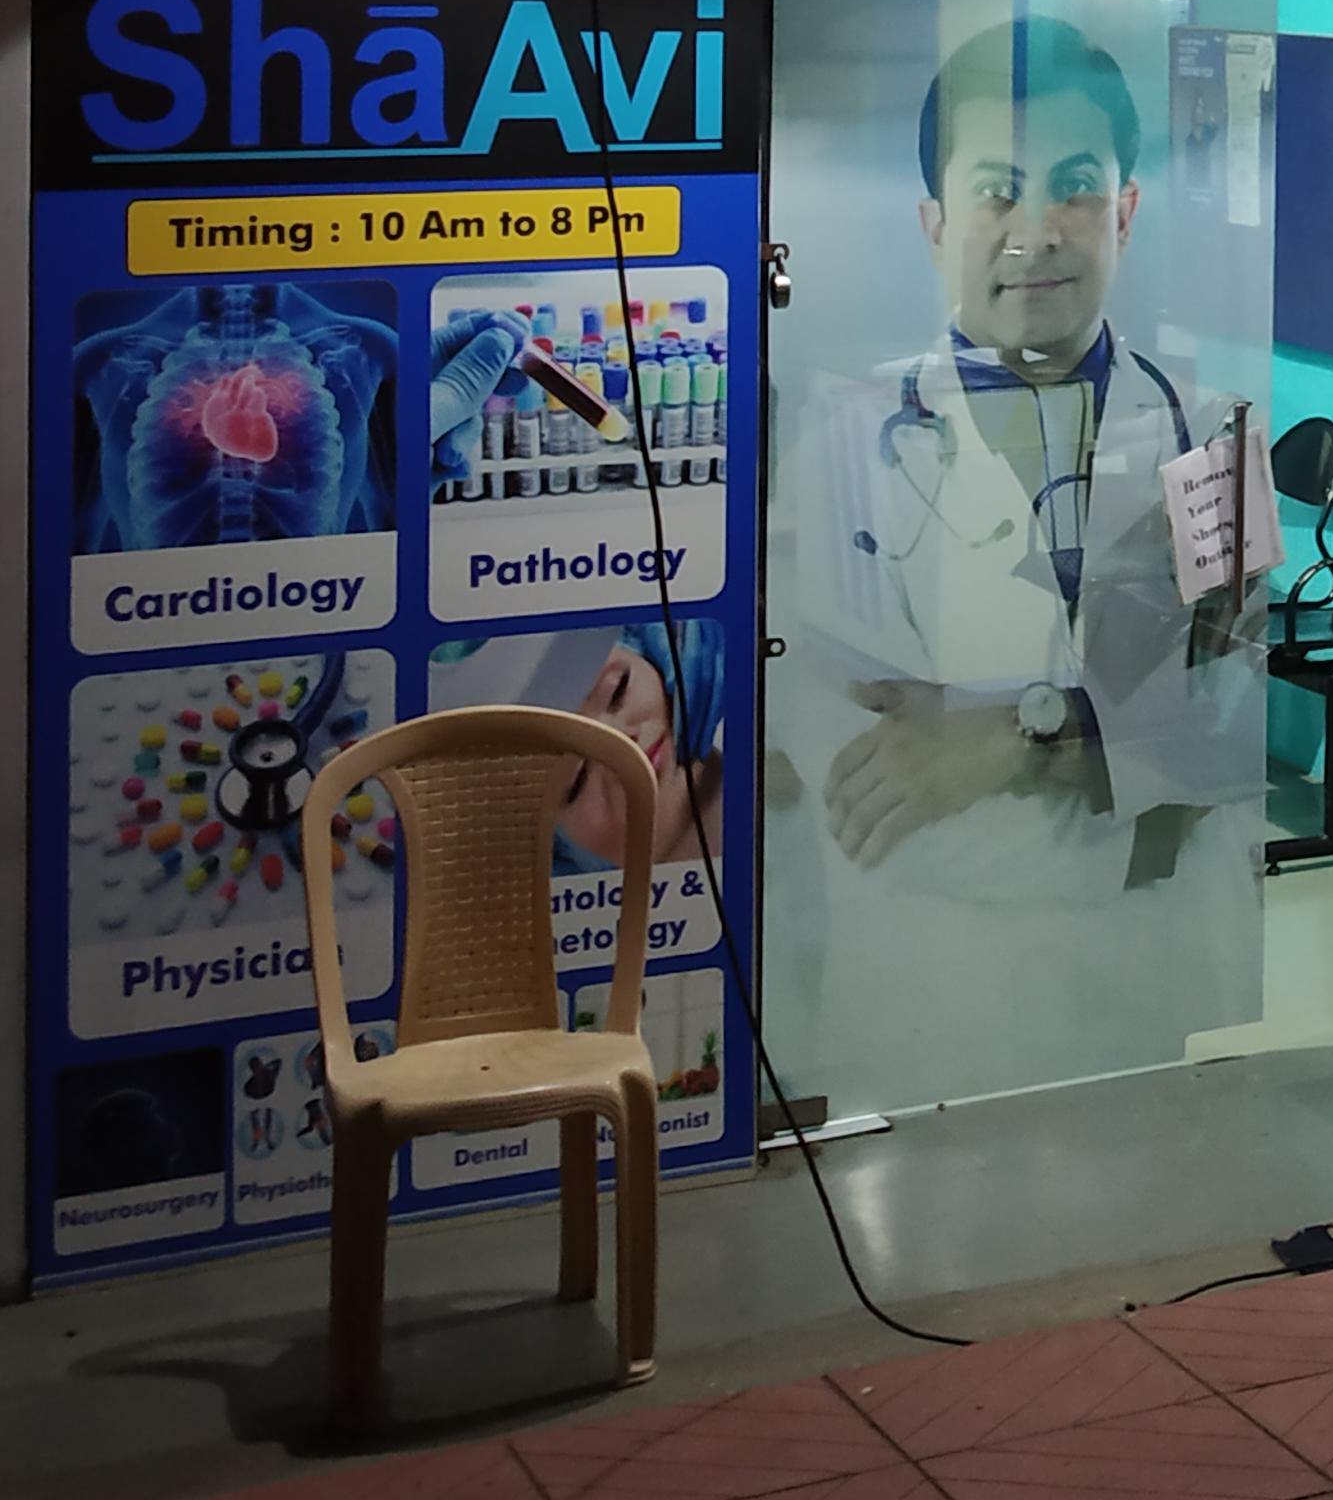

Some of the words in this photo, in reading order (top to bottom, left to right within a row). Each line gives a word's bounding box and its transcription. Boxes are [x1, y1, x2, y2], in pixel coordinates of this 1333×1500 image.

[170, 215, 314, 253] Timing
[360, 210, 406, 244] 10
[420, 208, 485, 240] Am
[500, 206, 536, 238] to
[551, 207, 572, 236] 8
[589, 204, 645, 233] Pm
[469, 543, 687, 590] Pathology
[104, 571, 365, 623] Cardiology
[680, 869, 704, 897] &
[122, 940, 344, 999] Physicia
[454, 1139, 528, 1168] Dental
[58, 1188, 220, 1230] Neurosurgery
